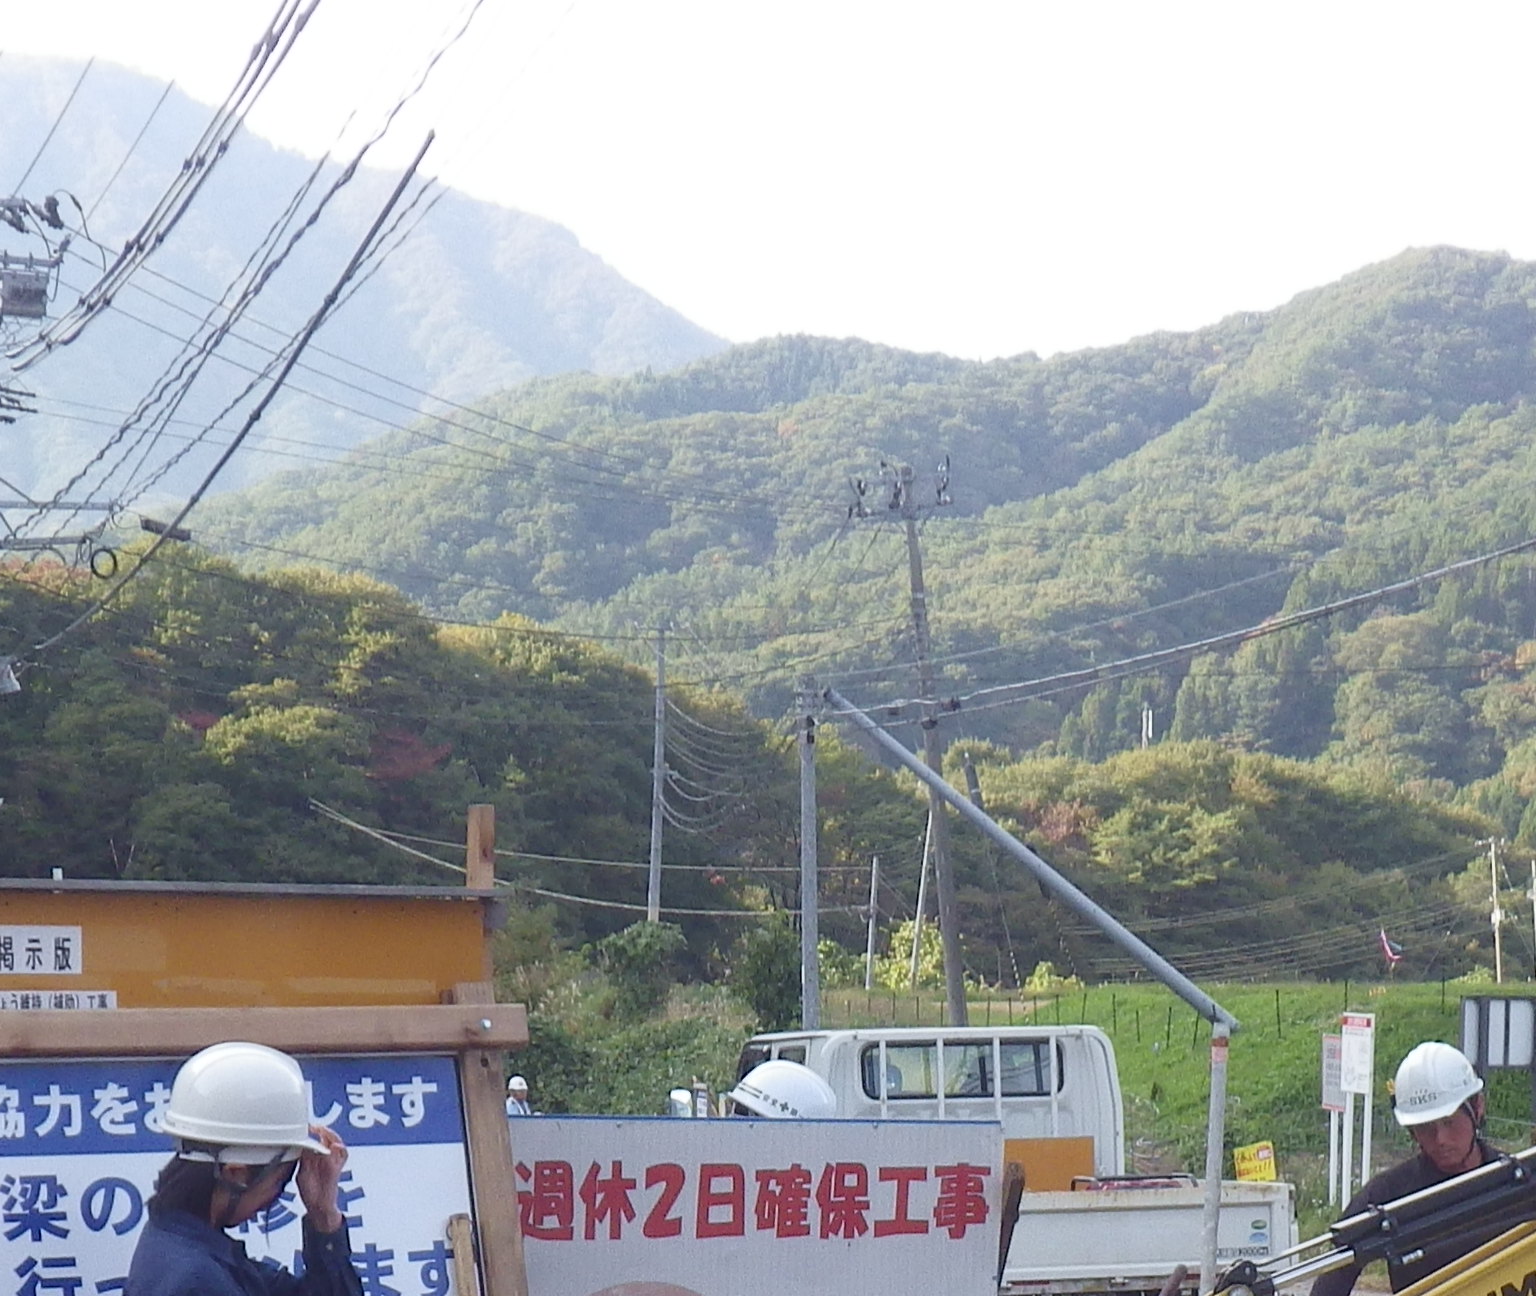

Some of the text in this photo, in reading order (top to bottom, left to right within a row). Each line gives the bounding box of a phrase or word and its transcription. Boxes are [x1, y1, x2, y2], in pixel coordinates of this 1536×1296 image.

[514, 1159, 993, 1241] 週休2日確保工事
